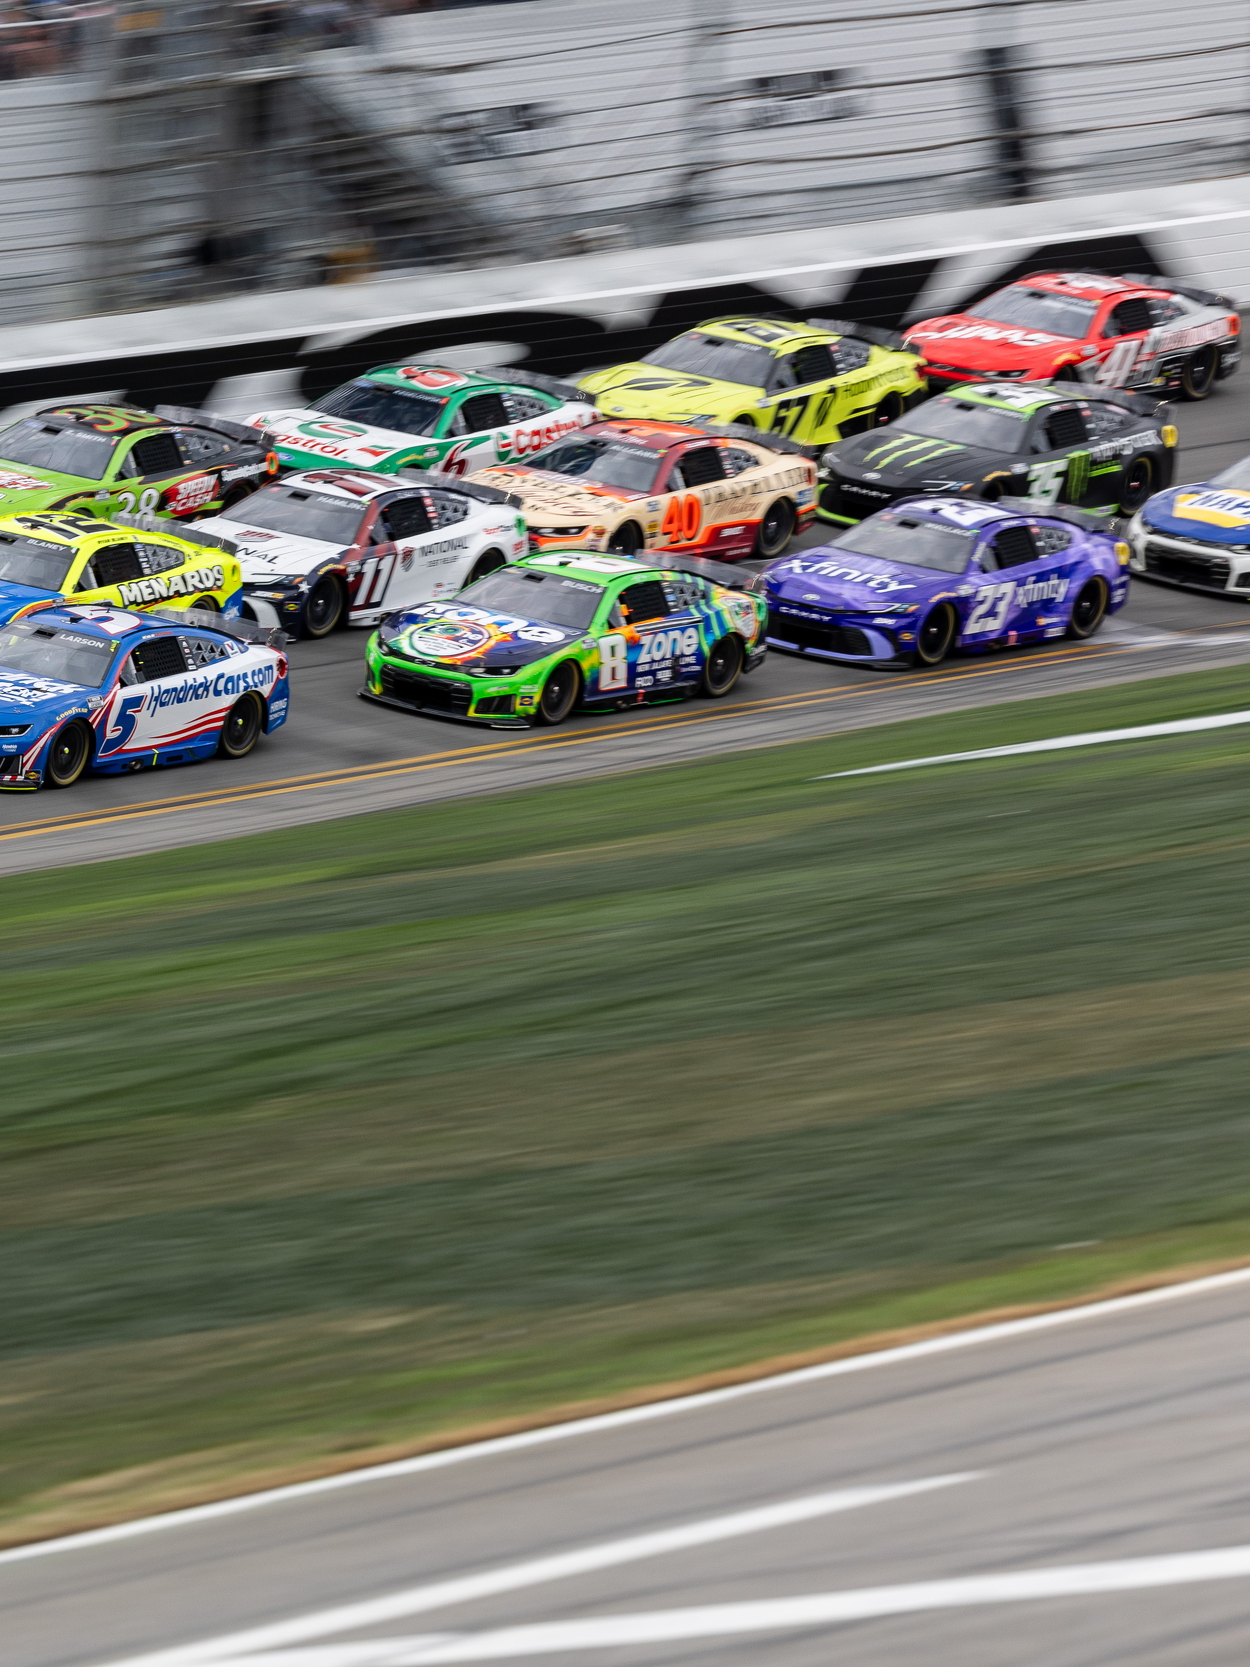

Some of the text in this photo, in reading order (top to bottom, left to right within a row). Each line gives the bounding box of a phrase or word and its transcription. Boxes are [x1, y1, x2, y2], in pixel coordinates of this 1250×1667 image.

[268, 431, 348, 457] astrol
[662, 494, 701, 544] 40
[1189, 491, 1250, 517] NAP
[27, 538, 67, 551] BLANEY
[118, 565, 225, 607] MENARDS
[352, 554, 396, 607] 11
[778, 559, 918, 593] xfinity
[402, 602, 566, 643] zone
[963, 581, 1018, 635] 23
[59, 634, 105, 648] LARSON
[636, 627, 699, 664] zone
[599, 635, 628, 690] 8
[56, 707, 88, 721] GOODYEAR
[100, 694, 147, 756] 5
